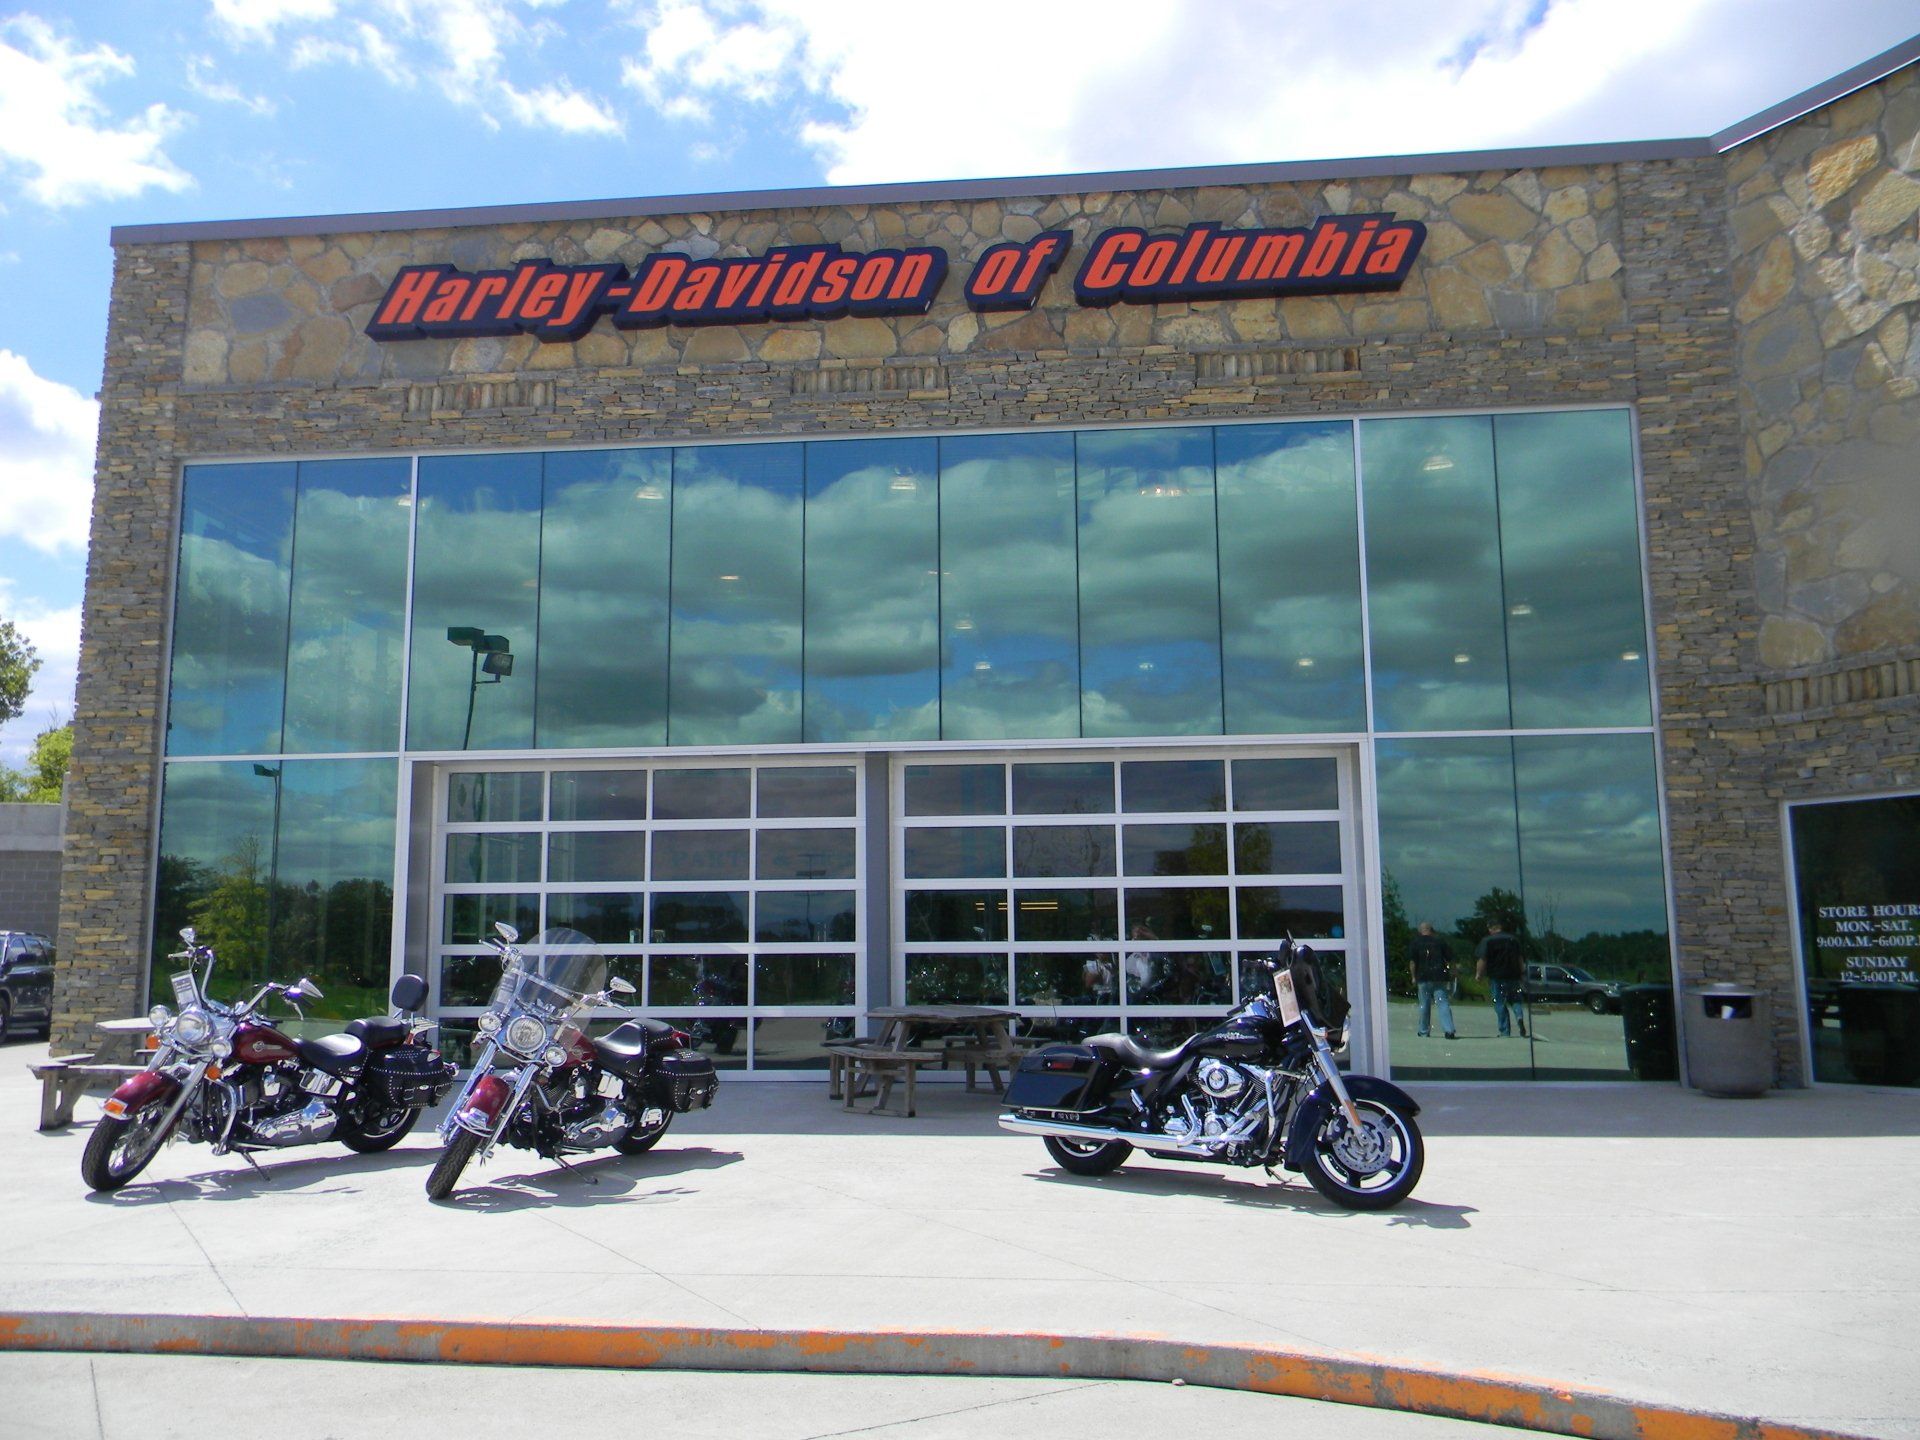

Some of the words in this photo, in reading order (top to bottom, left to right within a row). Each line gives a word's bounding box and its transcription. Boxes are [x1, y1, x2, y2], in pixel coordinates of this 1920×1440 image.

[377, 251, 935, 326] Harley-Davidson
[972, 238, 1057, 296] of
[1084, 220, 1414, 290] Columbia
[1819, 906, 1868, 918] STORE
[1835, 920, 1913, 932] MON.-SAT.
[1846, 956, 1909, 968] SUNDAY
